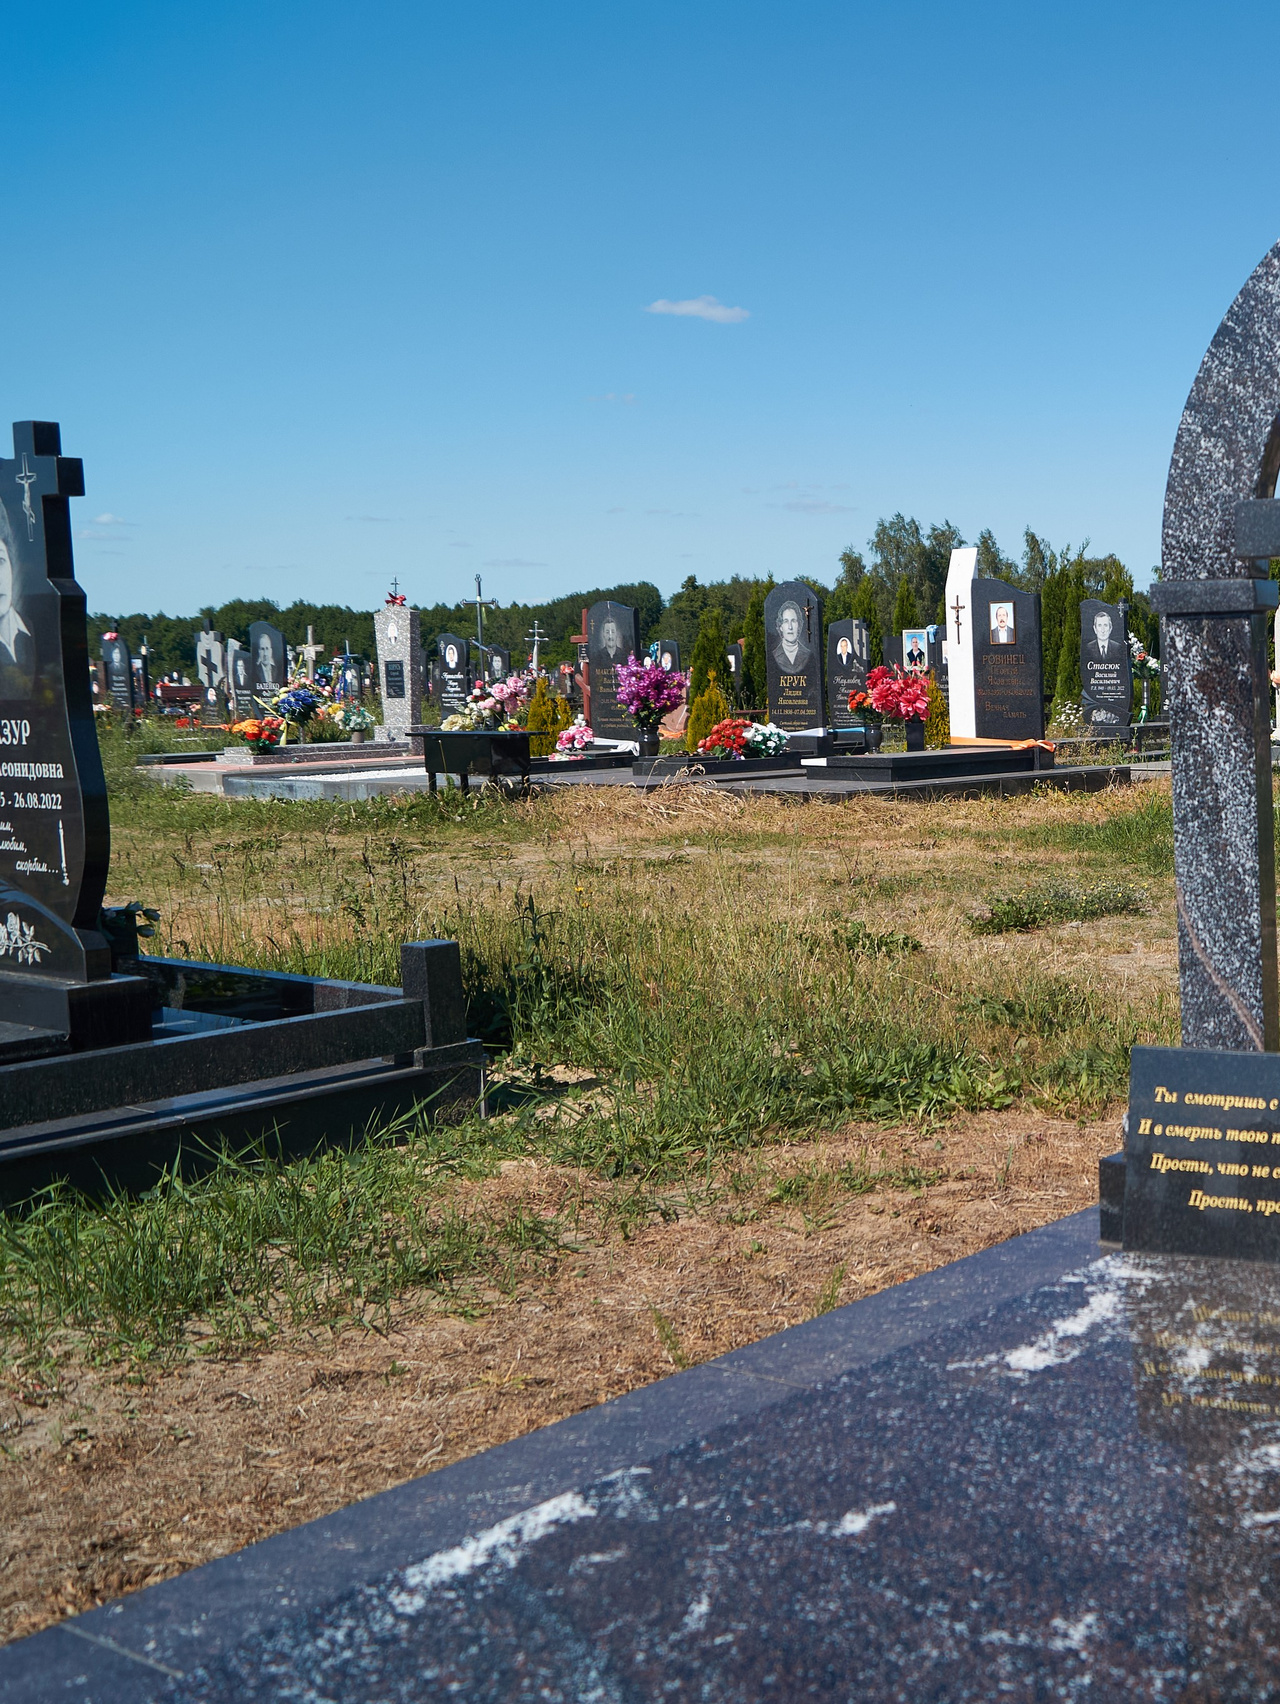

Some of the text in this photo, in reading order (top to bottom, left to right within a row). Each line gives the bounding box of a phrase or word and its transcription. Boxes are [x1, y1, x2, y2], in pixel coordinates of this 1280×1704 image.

[982, 654, 1025, 665] РОВИНЕЦ
[1087, 661, 1120, 670] Стасюк
[779, 676, 807, 686] КРУК
[0, 719, 30, 745] ЗУР
[14, 792, 62, 810] 26.08.2022
[1155, 1087, 1177, 1102] Ты
[1184, 1093, 1266, 1110] смотришь
[1270, 1099, 1278, 1110] с
[1138, 1119, 1152, 1134] И
[1154, 1125, 1162, 1135] в
[1165, 1125, 1222, 1141] смерть
[1226, 1129, 1269, 1143] твою
[1150, 1153, 1213, 1174] Прости,
[1218, 1163, 1249, 1176] что
[1252, 1166, 1270, 1178] не
[1188, 1190, 1253, 1212] Прости,
